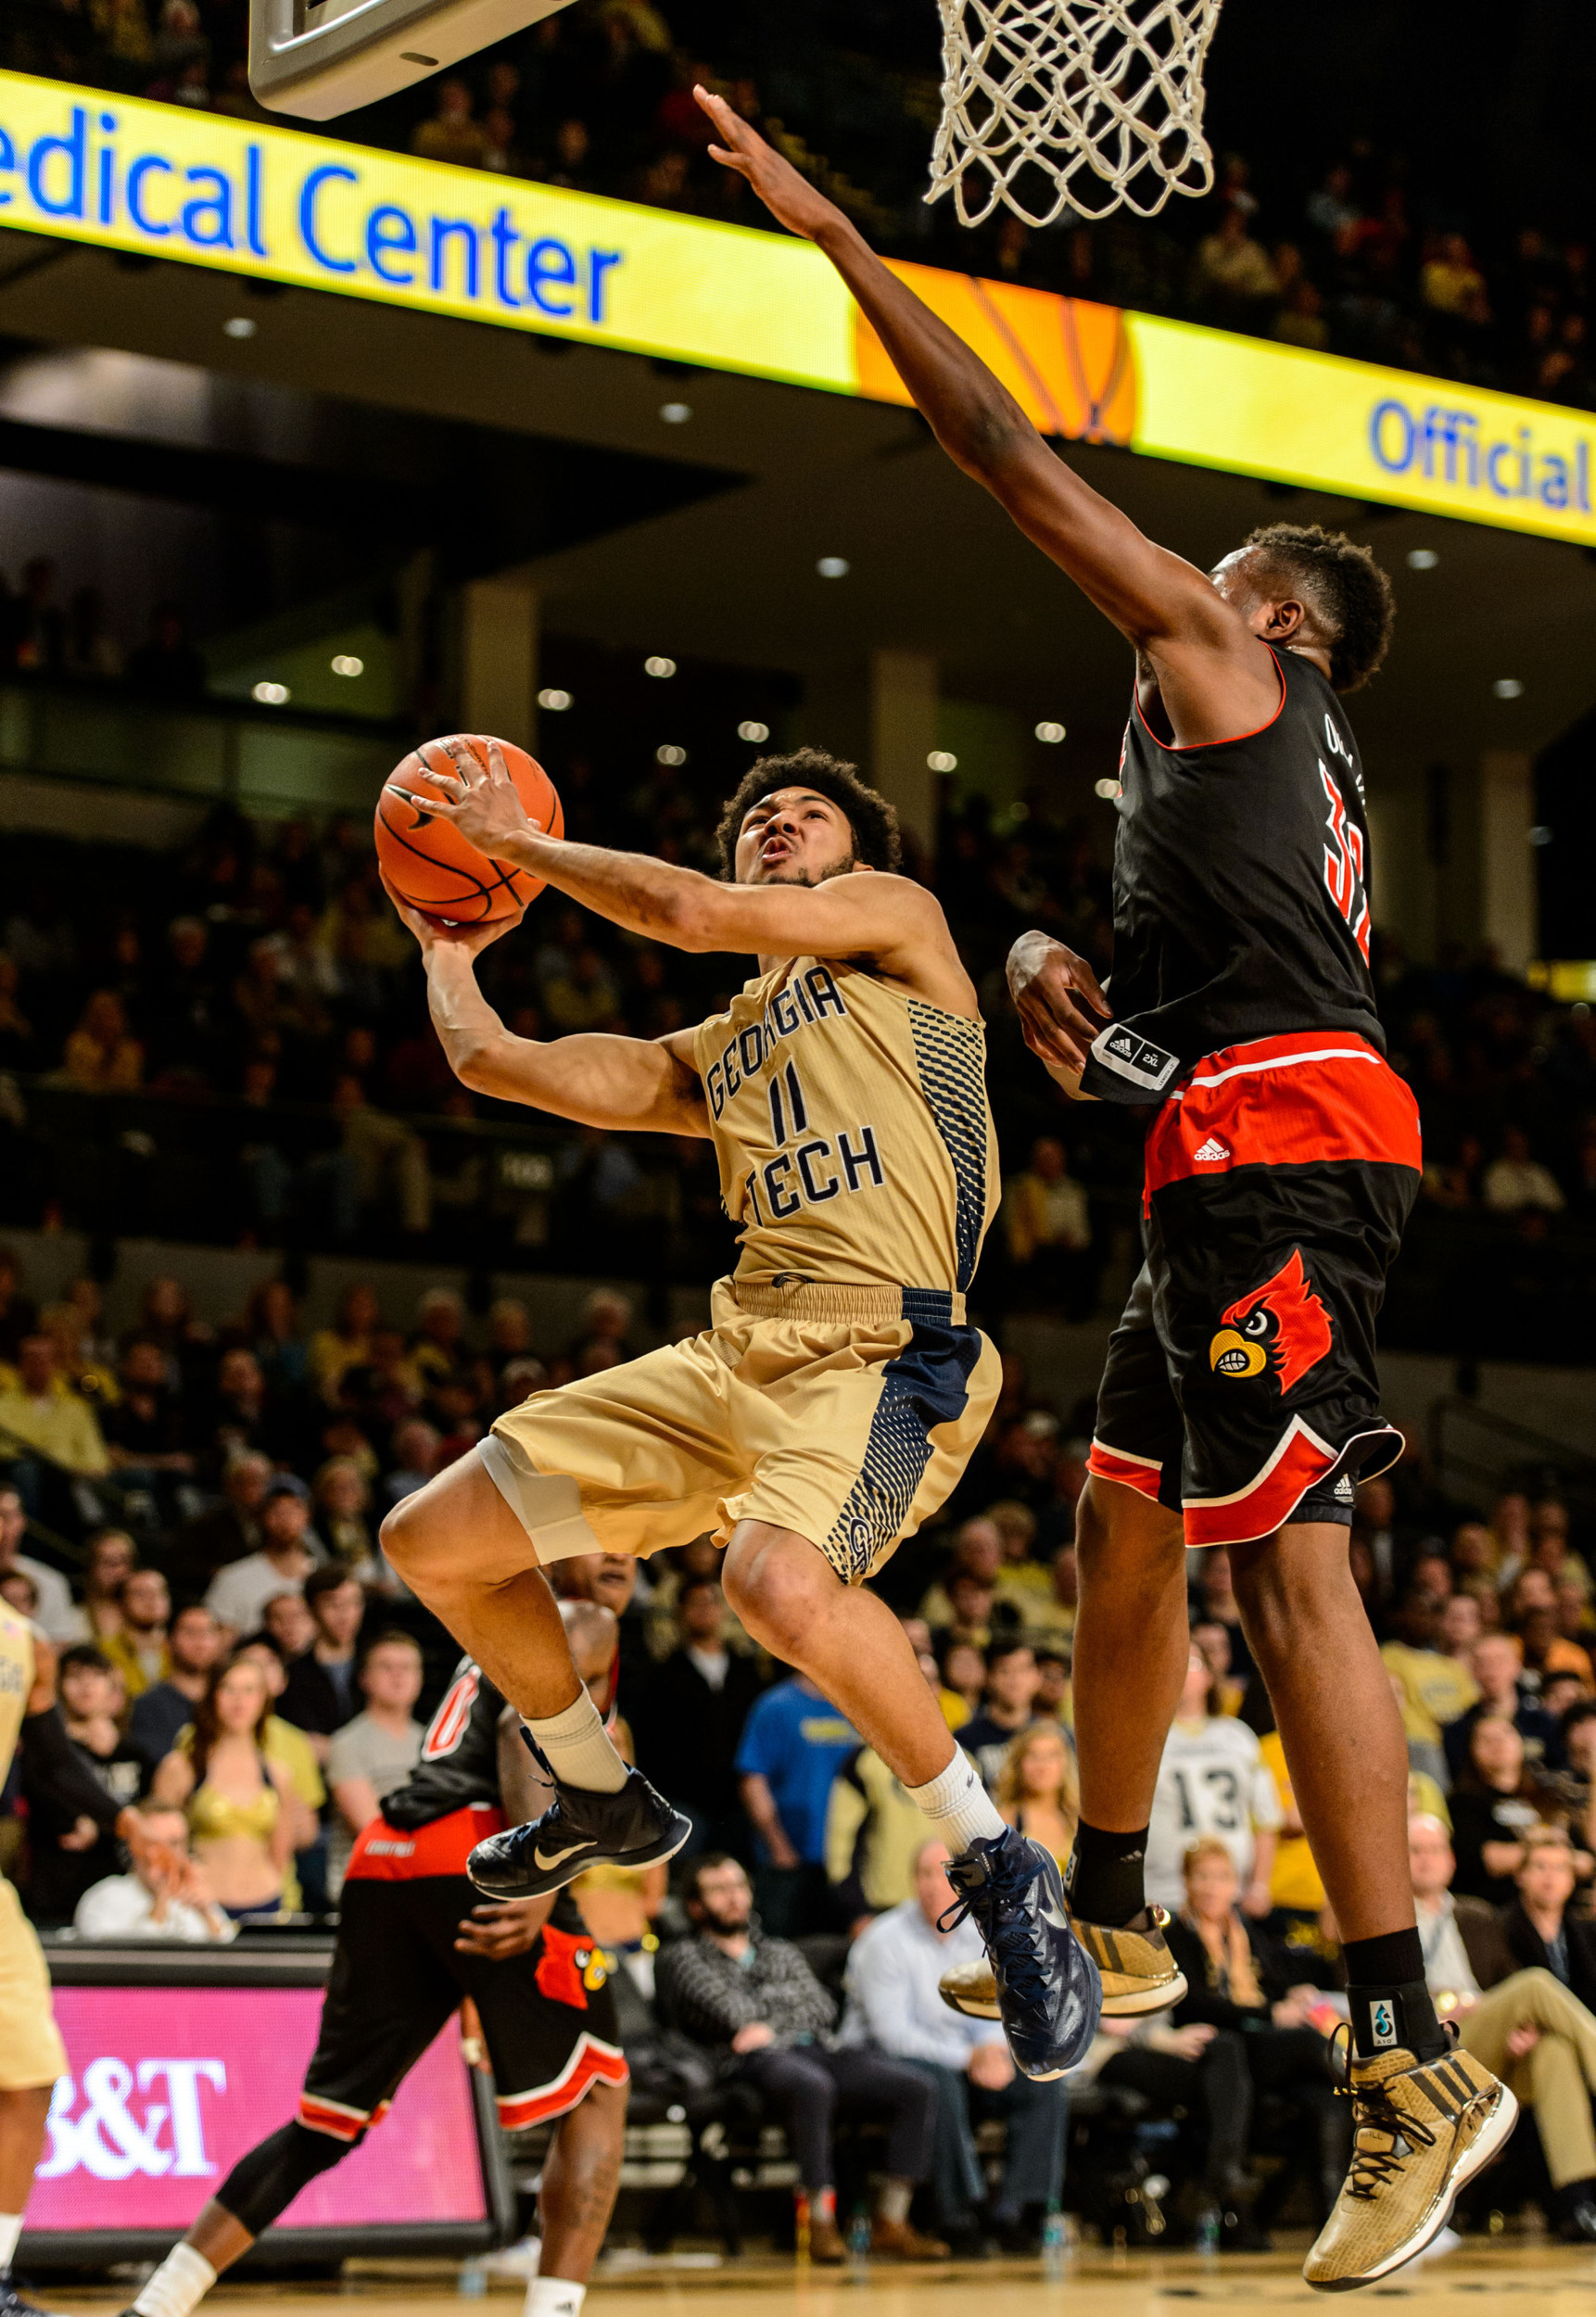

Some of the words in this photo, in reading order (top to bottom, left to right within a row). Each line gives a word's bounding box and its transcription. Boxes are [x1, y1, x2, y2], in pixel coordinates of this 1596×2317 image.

[298, 164, 623, 323] Center
[1368, 398, 1592, 513] Official
[766, 1055, 810, 1151] 11
[1142, 1053, 1159, 1068] 2XL
[744, 1124, 886, 1229] TECH
[1194, 1149, 1231, 1161] adidas
[1172, 1766, 1240, 1832] 13
